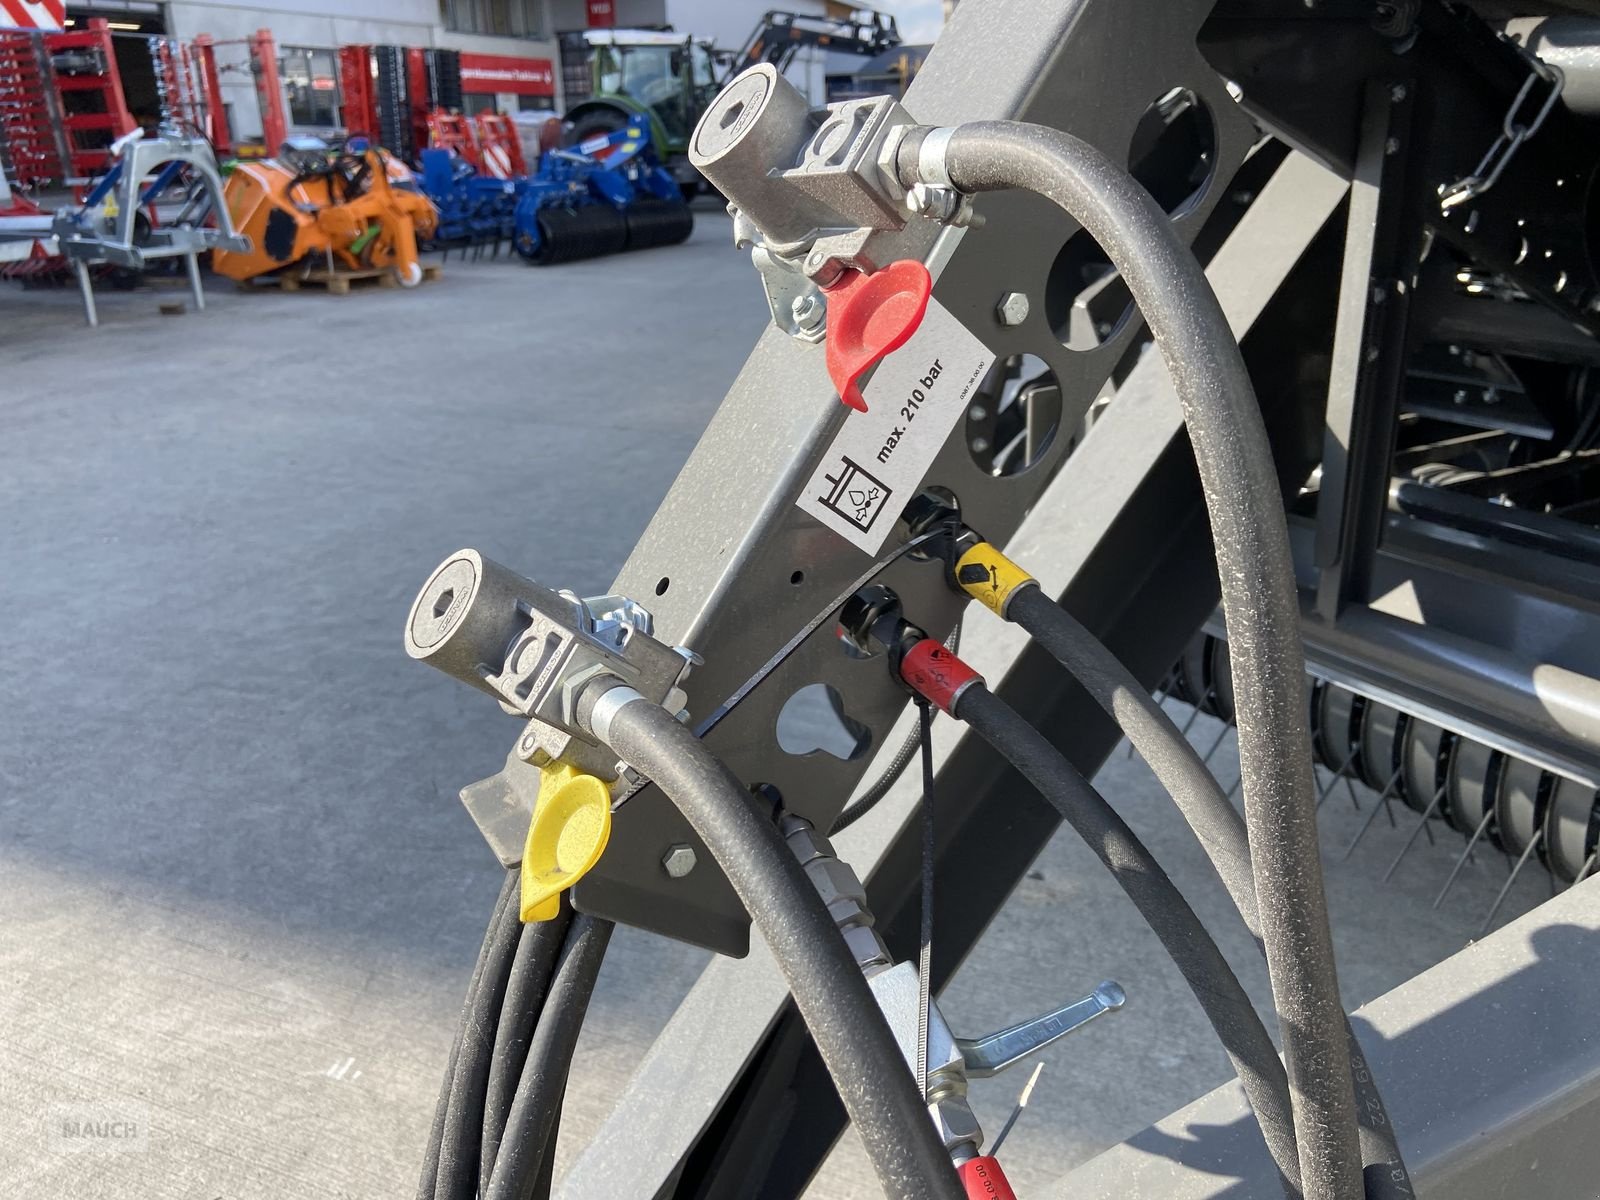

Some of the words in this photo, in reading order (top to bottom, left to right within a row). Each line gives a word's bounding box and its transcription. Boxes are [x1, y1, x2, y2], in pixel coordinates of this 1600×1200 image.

[876, 426, 907, 464] max.
[900, 389, 925, 423] 210
[919, 358, 943, 390] bar
